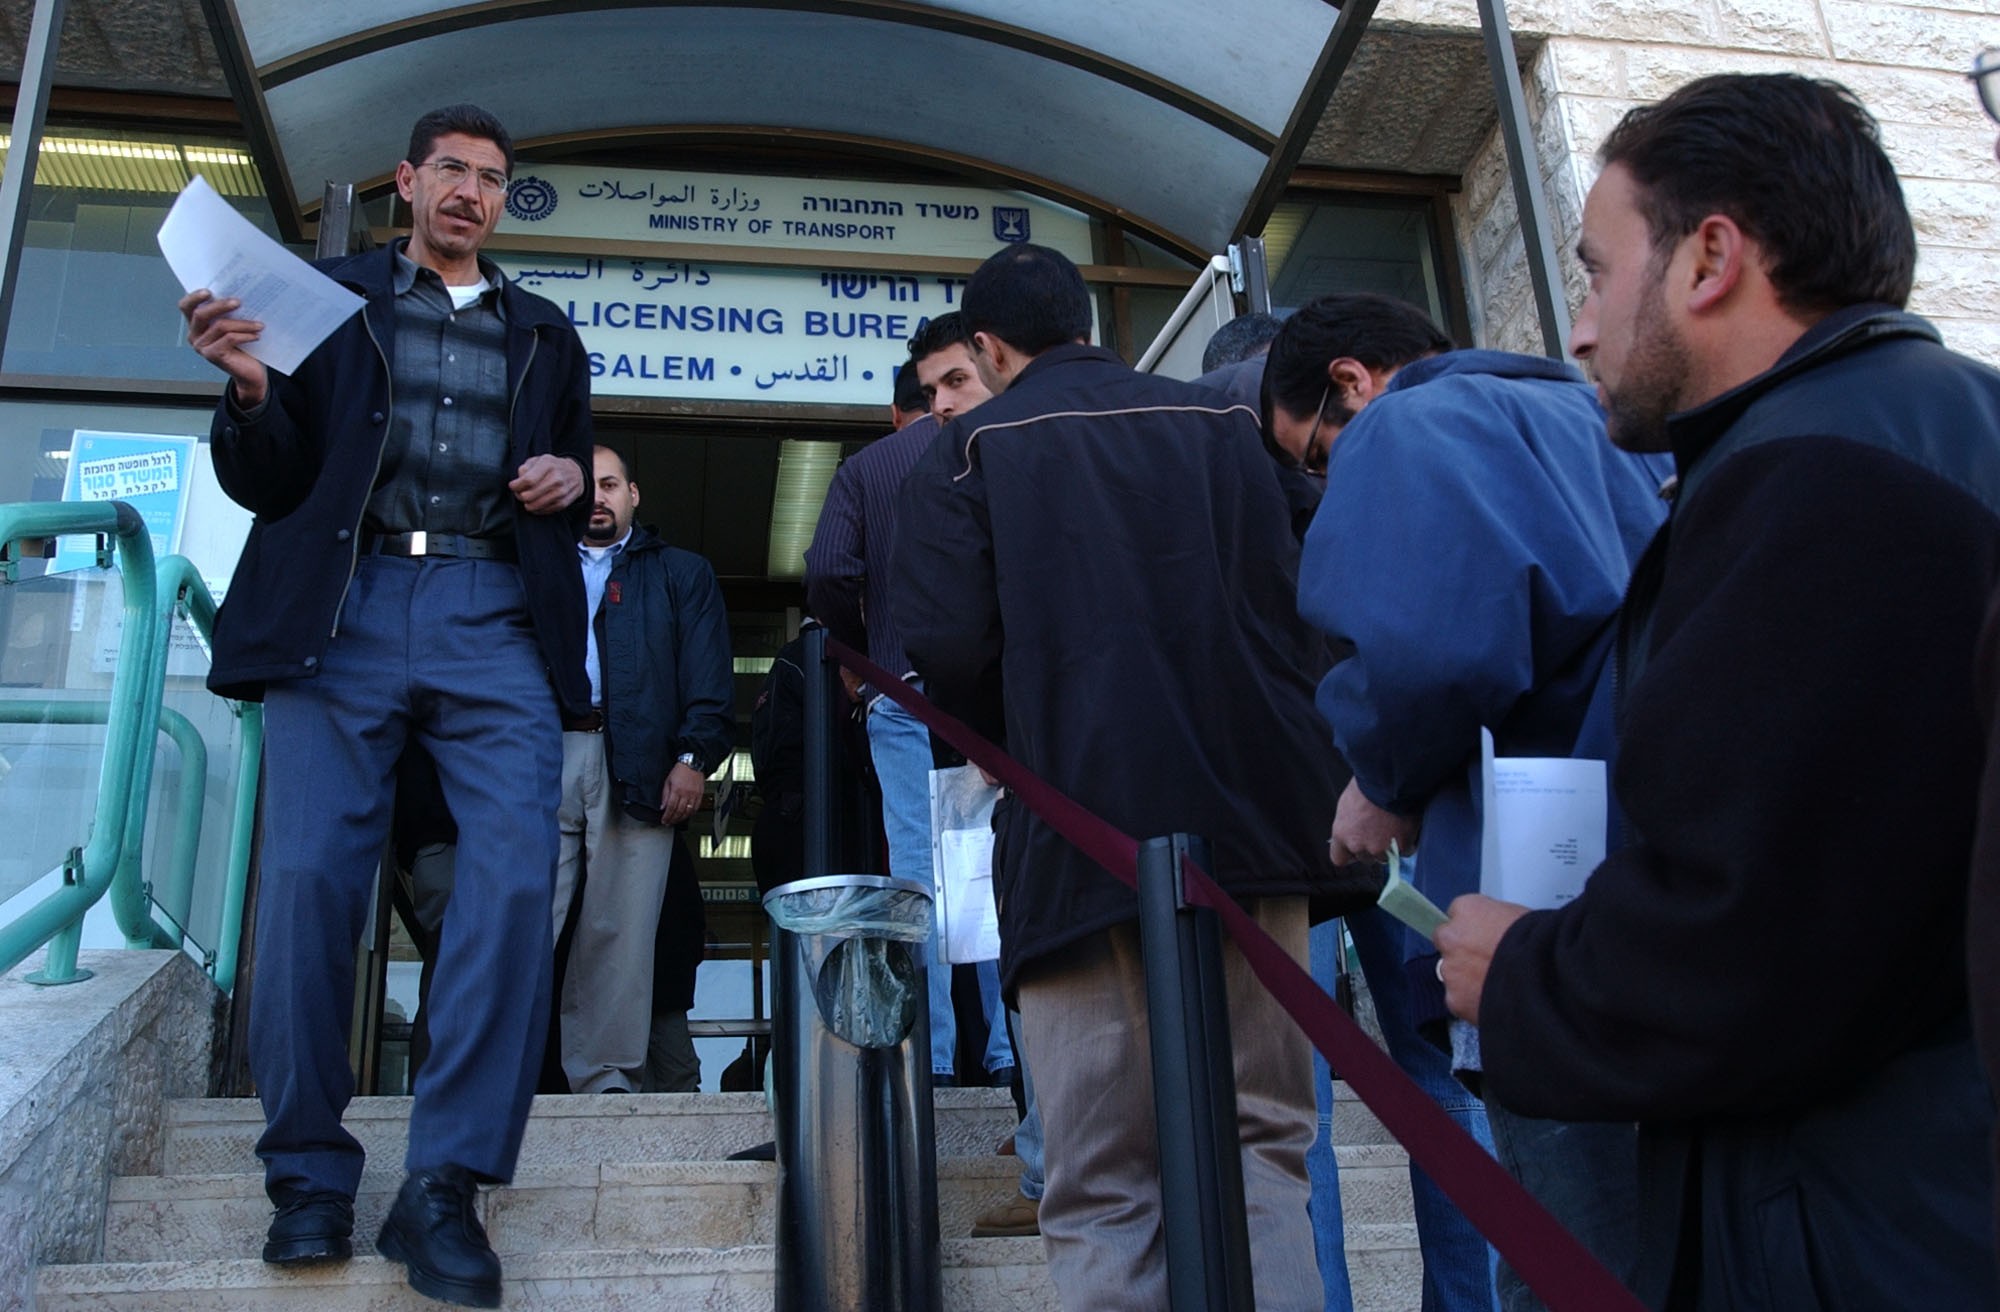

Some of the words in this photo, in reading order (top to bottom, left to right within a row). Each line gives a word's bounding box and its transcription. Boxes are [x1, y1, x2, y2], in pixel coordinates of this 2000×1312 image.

[578, 179, 695, 208] المواصلات
[710, 187, 760, 212] وزارة
[802, 196, 903, 217] התחבורה
[915, 202, 979, 220] משרד
[649, 214, 738, 232] MINISTRY
[748, 219, 773, 235] OF
[782, 220, 896, 241] TRANSPORT
[511, 258, 603, 286] السير
[631, 260, 711, 291] دائرة
[820, 272, 920, 303] הרישוי
[568, 300, 784, 334] LICENSING
[804, 311, 931, 341] BUREA
[587, 352, 715, 382] SALEM
[755, 354, 848, 390] القدس
[84, 463, 115, 476] מרוכזת
[118, 459, 149, 472] חופשה
[151, 453, 172, 467] לרגל
[83, 473, 115, 490] סגור
[119, 465, 173, 485] המשרד
[93, 489, 118, 499] קהל
[126, 481, 166, 494] לקבלת
